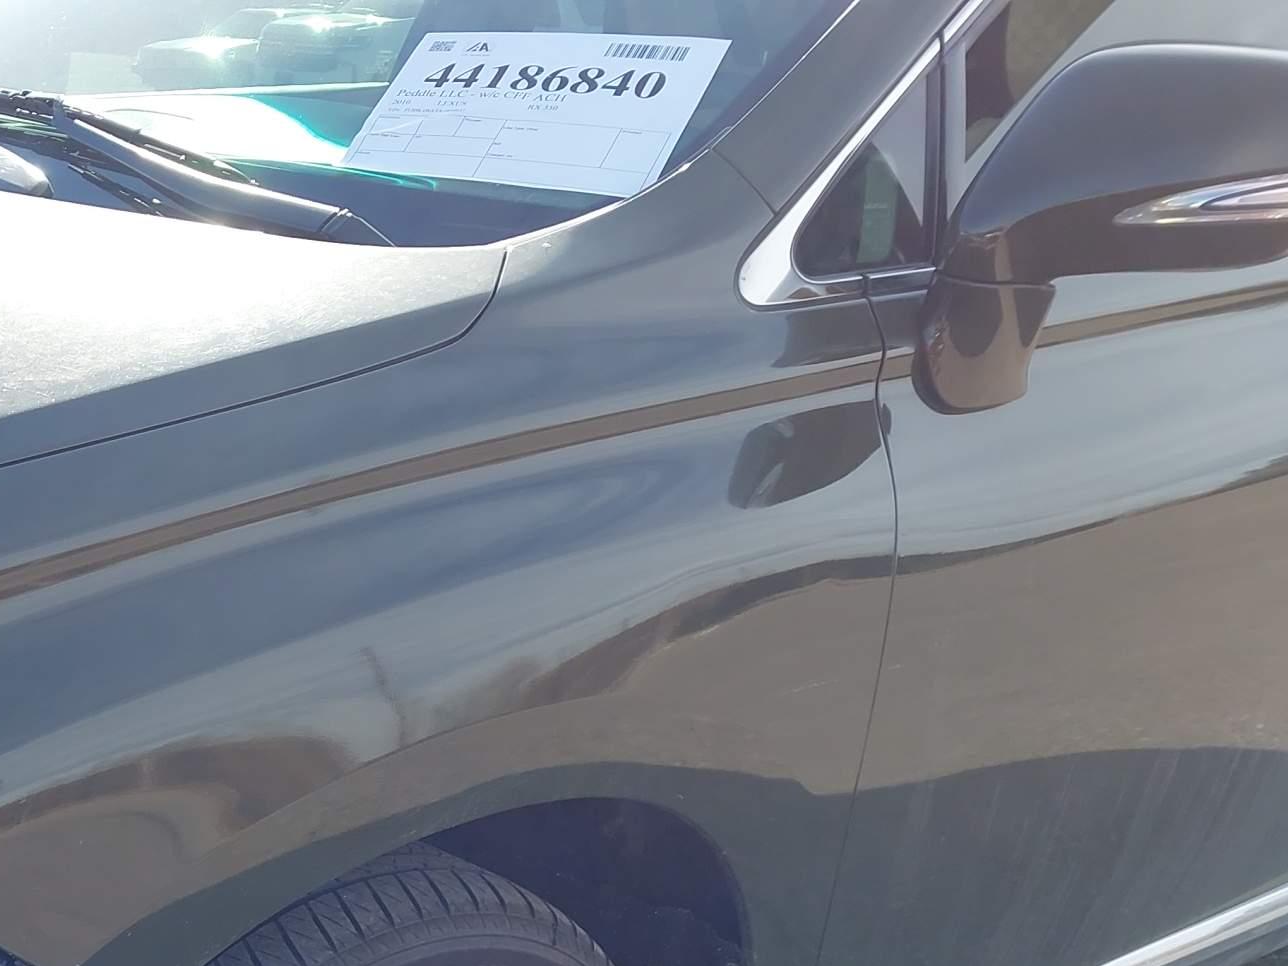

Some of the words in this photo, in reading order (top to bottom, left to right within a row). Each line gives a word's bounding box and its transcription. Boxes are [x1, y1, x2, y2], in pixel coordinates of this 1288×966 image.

[424, 62, 667, 100] 44186840
[396, 89, 437, 98] Peddle
[439, 89, 469, 98] LLC
